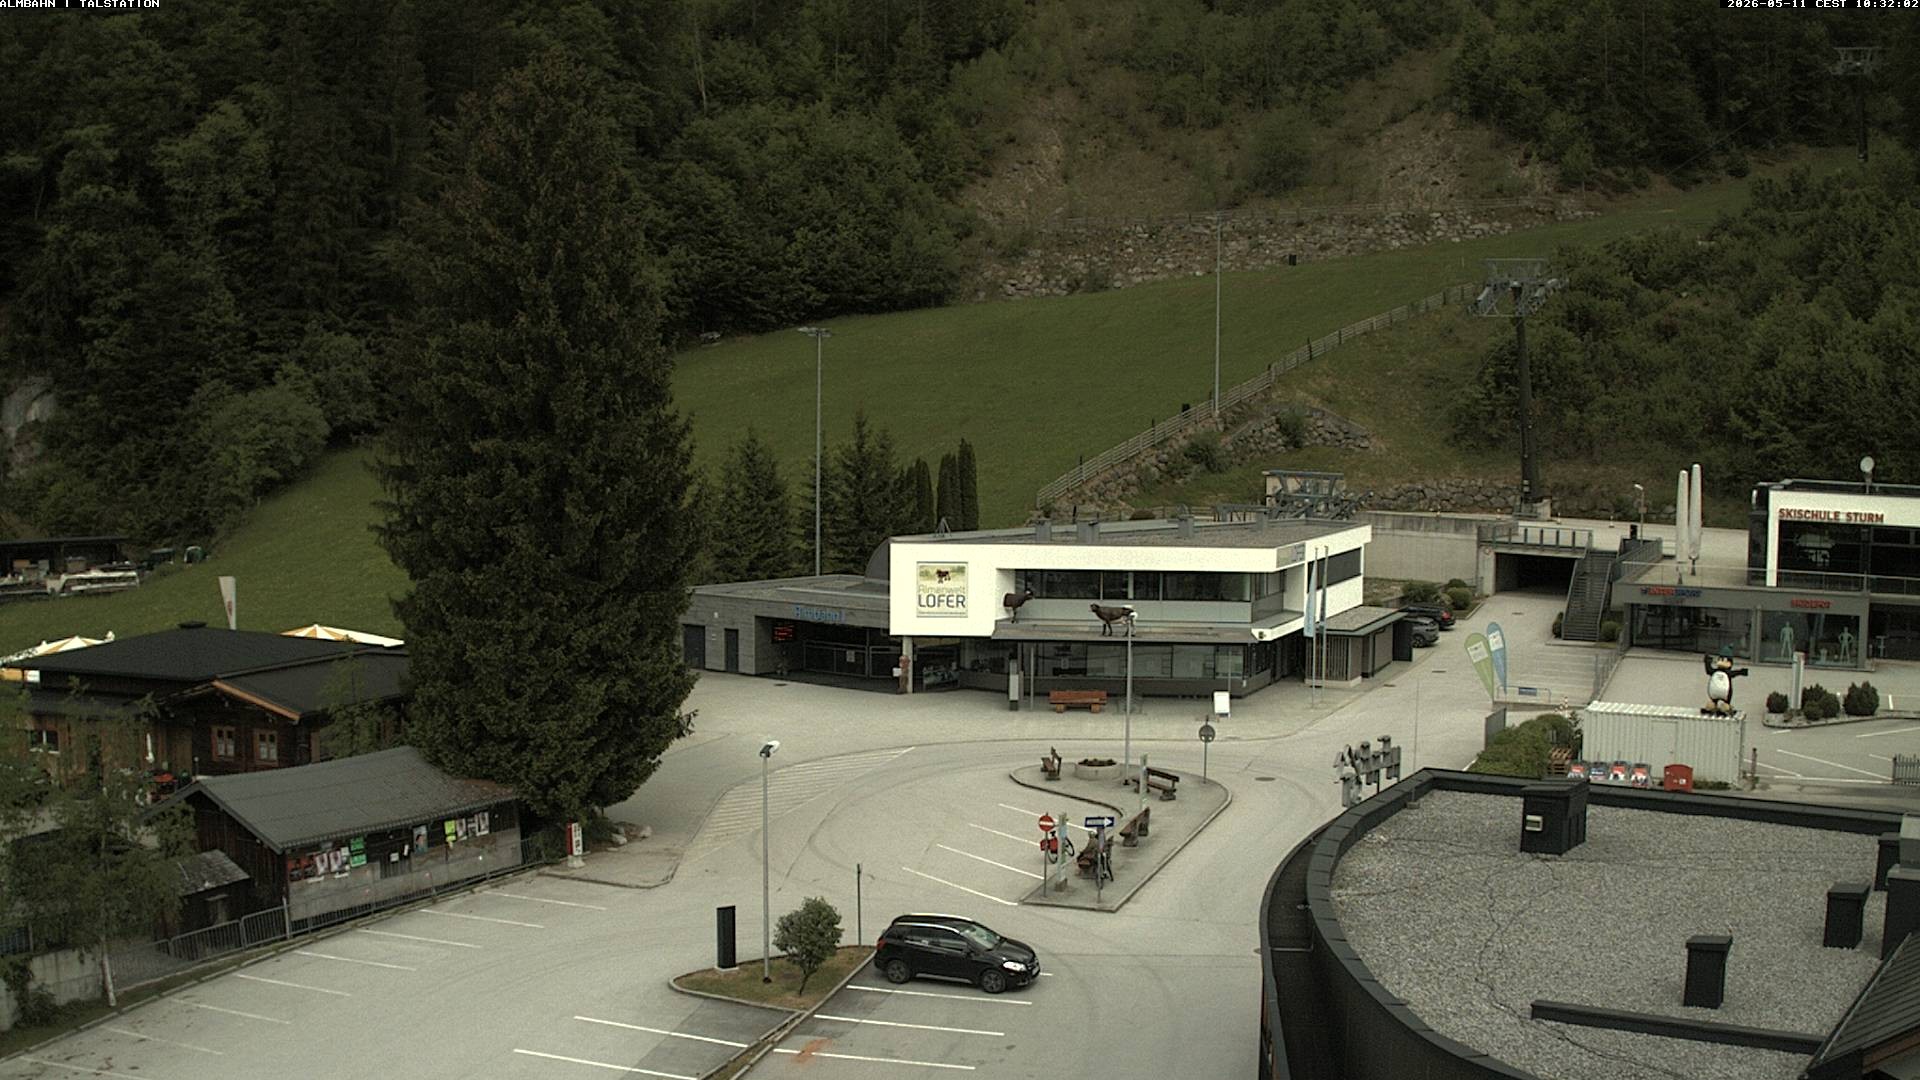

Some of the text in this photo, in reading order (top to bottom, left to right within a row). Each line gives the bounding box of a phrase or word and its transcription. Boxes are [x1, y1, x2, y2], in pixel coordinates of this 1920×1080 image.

[1778, 508, 1884, 523] SKISCHULE STURM
[918, 594, 966, 608] LOFER
